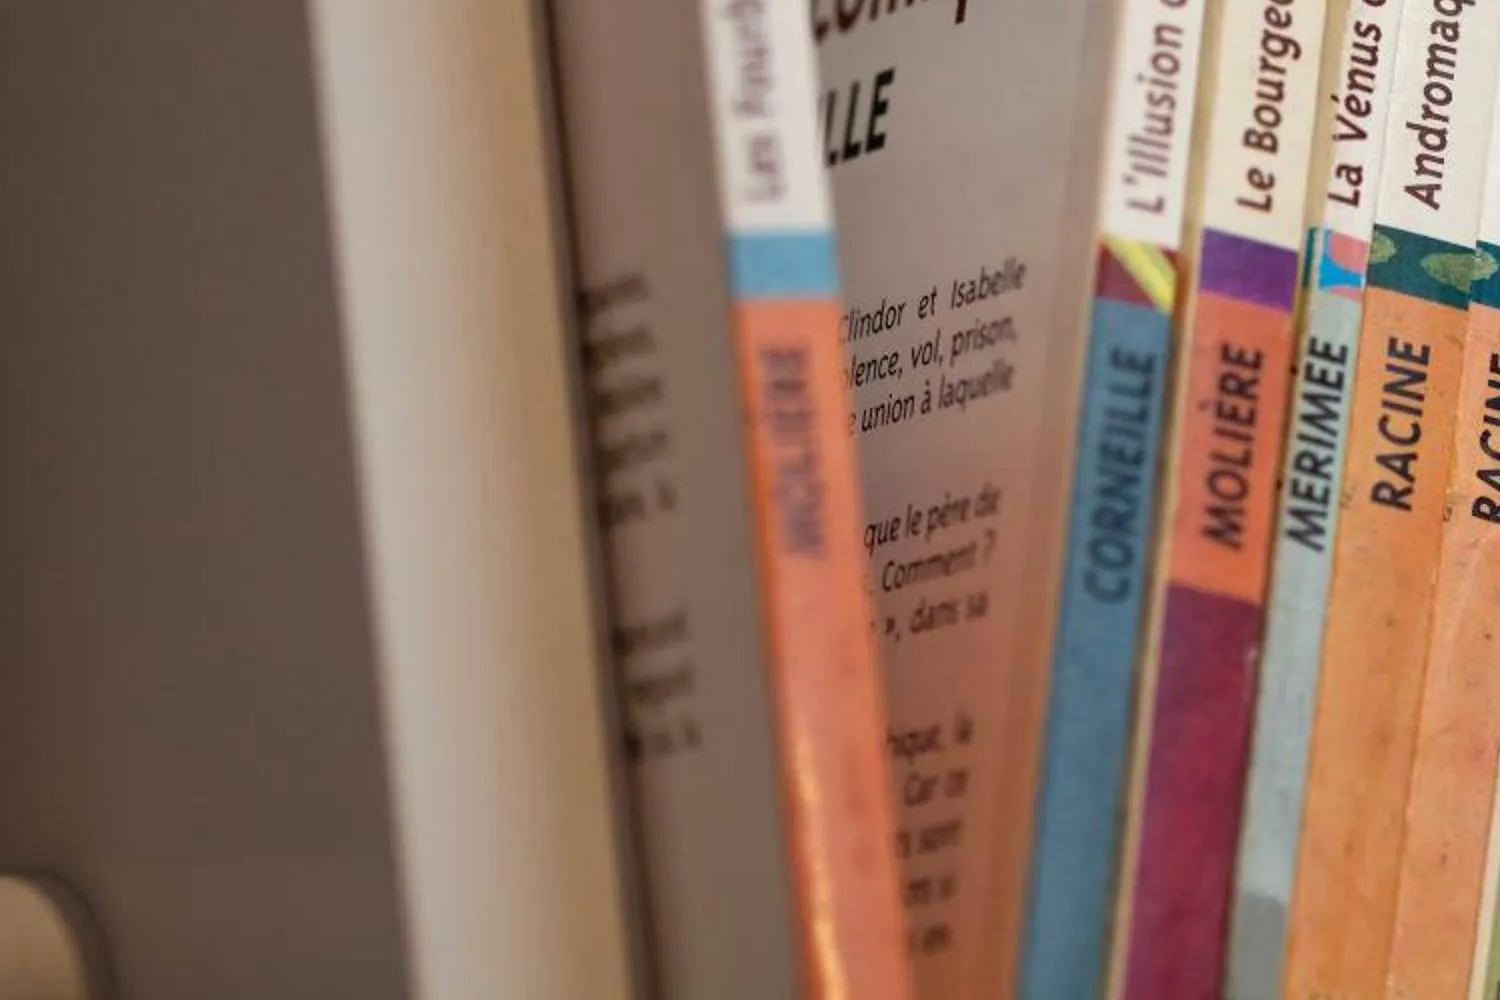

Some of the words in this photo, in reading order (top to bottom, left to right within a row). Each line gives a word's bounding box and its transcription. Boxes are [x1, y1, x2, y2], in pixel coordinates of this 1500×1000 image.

[822, 66, 896, 168] LLE
[1329, 19, 1383, 145] Vénus
[1125, 23, 1185, 216] L'Illusion
[1236, 167, 1275, 214] Le
[1327, 165, 1363, 208] La
[917, 285, 939, 320] et
[950, 256, 1028, 311] Isabelle
[844, 350, 903, 390] lence,
[911, 327, 945, 370] vol,
[860, 393, 916, 433] union
[919, 378, 933, 416] à
[938, 357, 1016, 412] laquelle
[1371, 335, 1432, 513] RACINE
[1084, 347, 1158, 606] CORNEILLE
[863, 515, 901, 560] que
[905, 502, 923, 538] le
[881, 540, 978, 592] Comment
